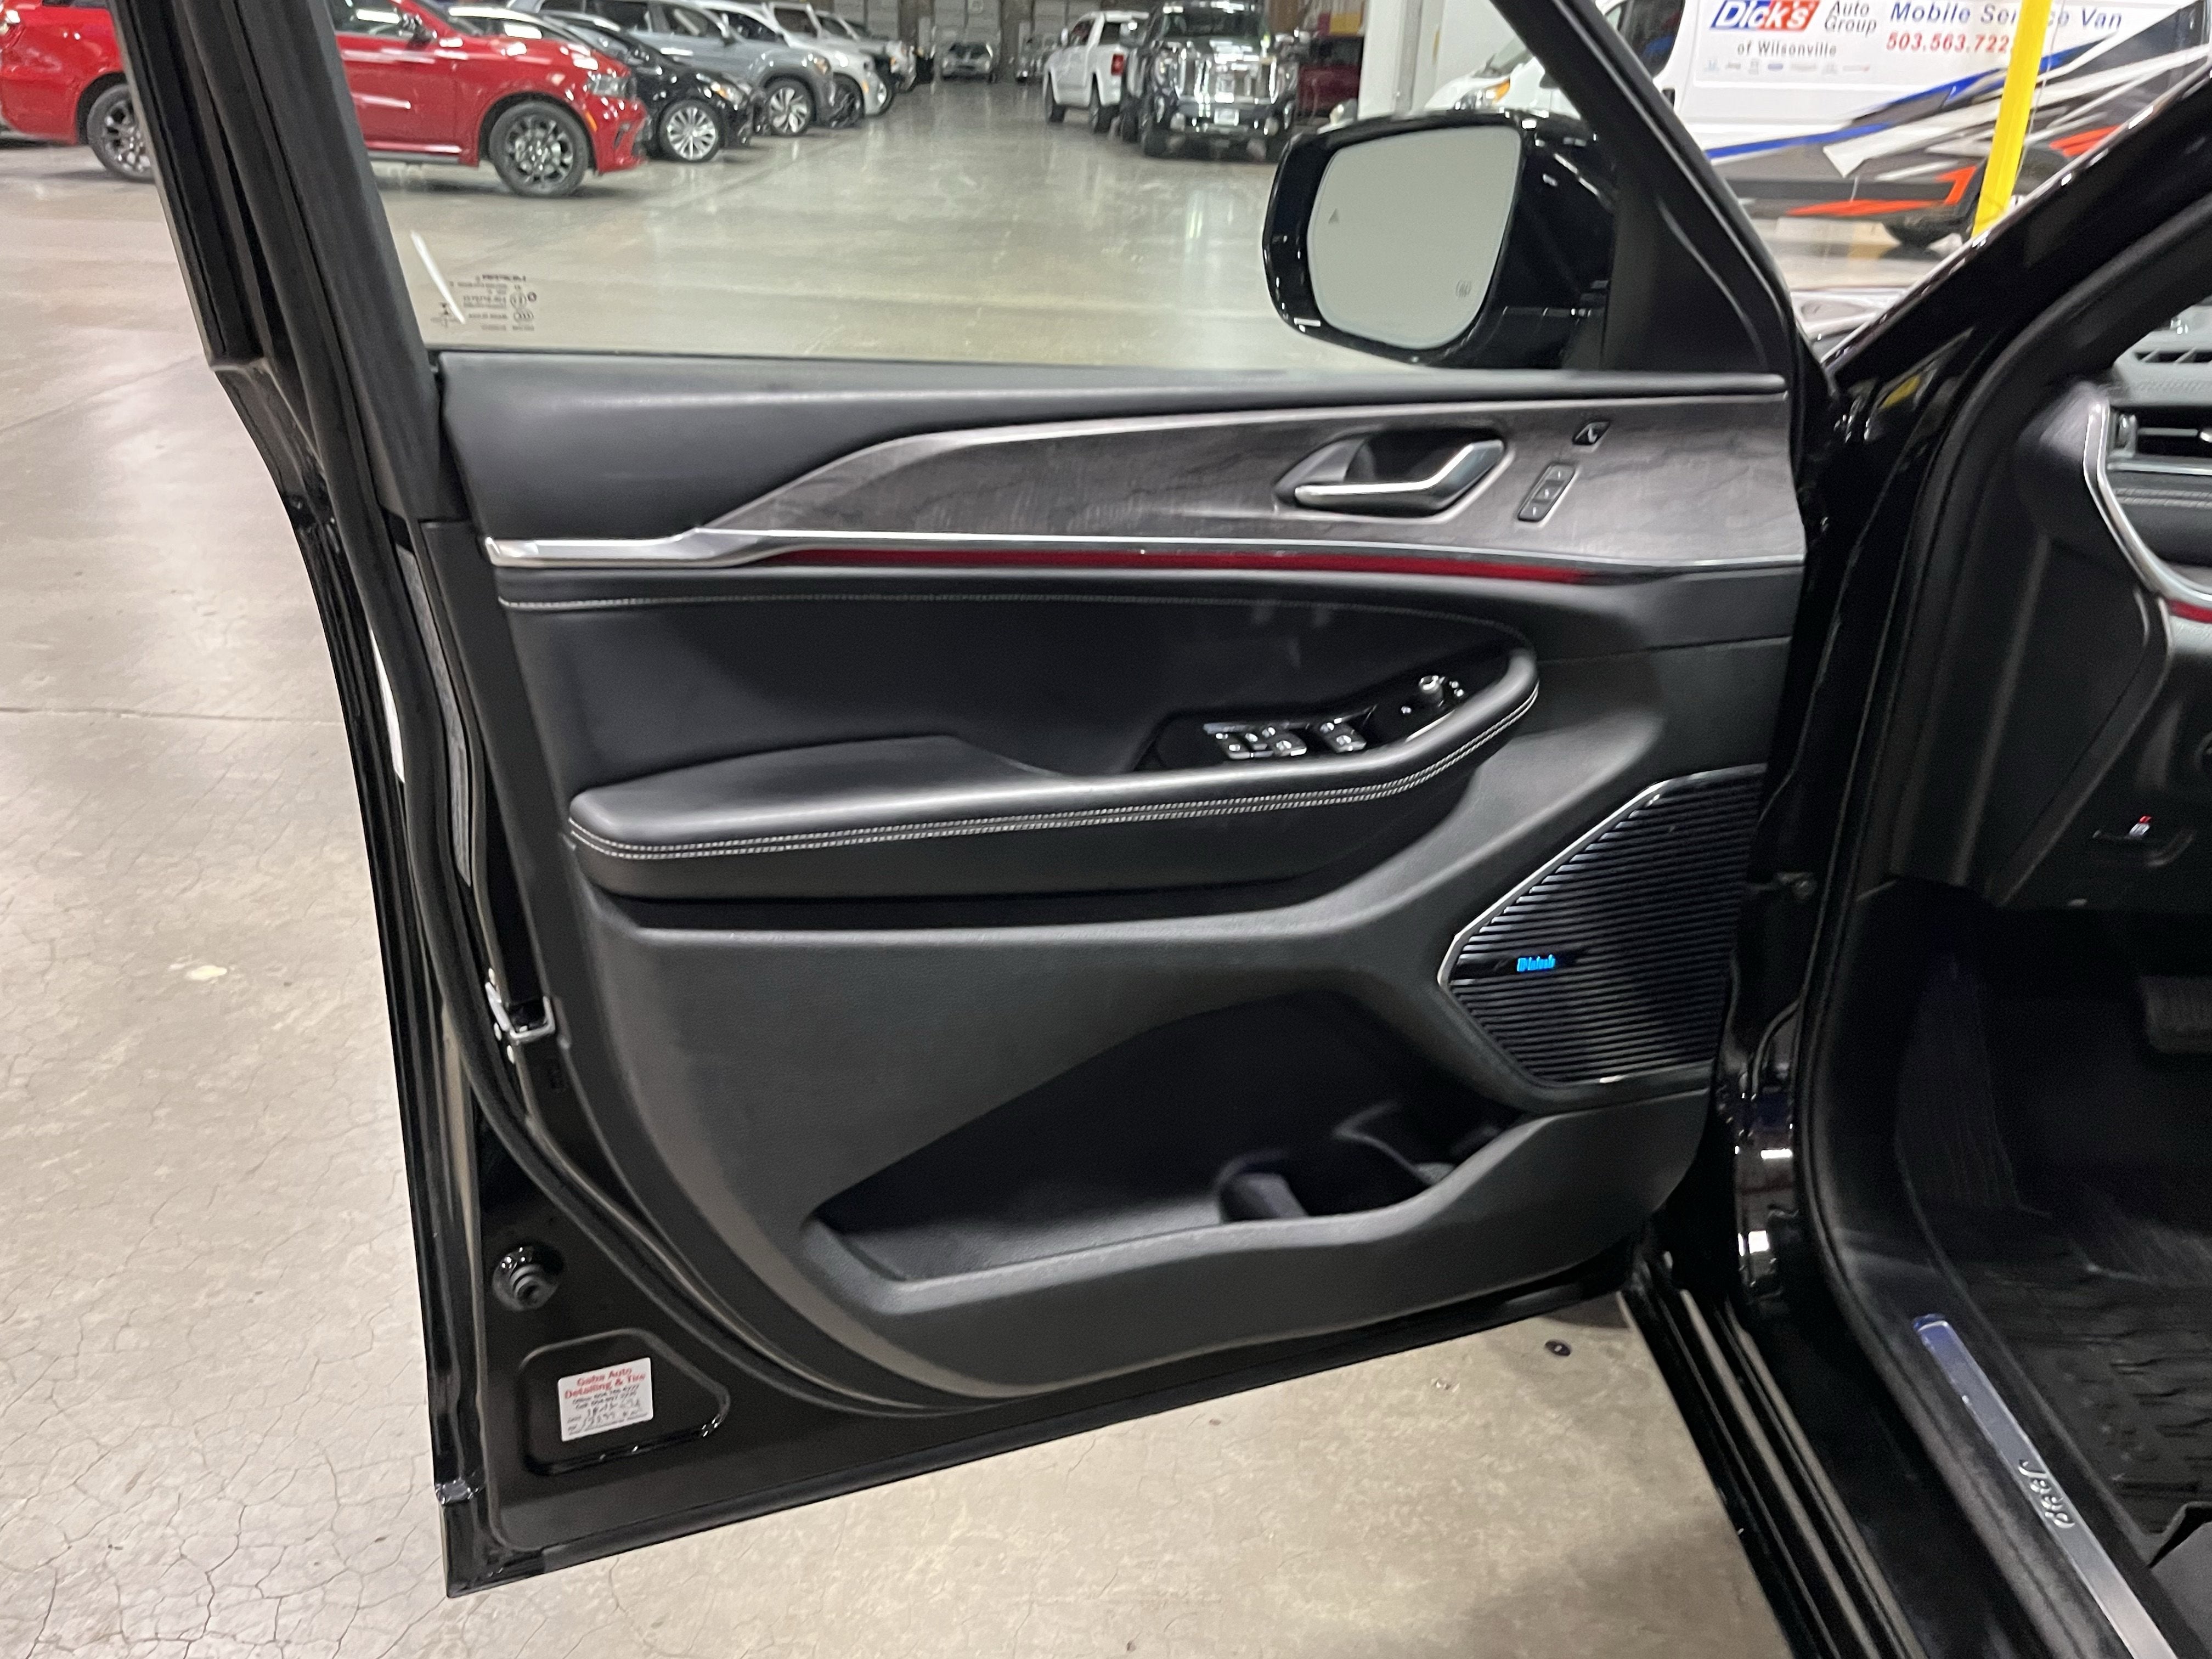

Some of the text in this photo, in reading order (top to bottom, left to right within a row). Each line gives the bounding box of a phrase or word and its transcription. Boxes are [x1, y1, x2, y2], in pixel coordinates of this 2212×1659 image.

[1829, 1, 1870, 17] Auto
[1890, 2, 1971, 24] Mobile
[2082, 8, 2123, 30] Van
[1825, 15, 1877, 36] Group
[1737, 40, 1837, 58] of Wilsonville
[1886, 31, 2012, 53] 503.563.722
[2018, 1461, 2075, 1528] Jeep
